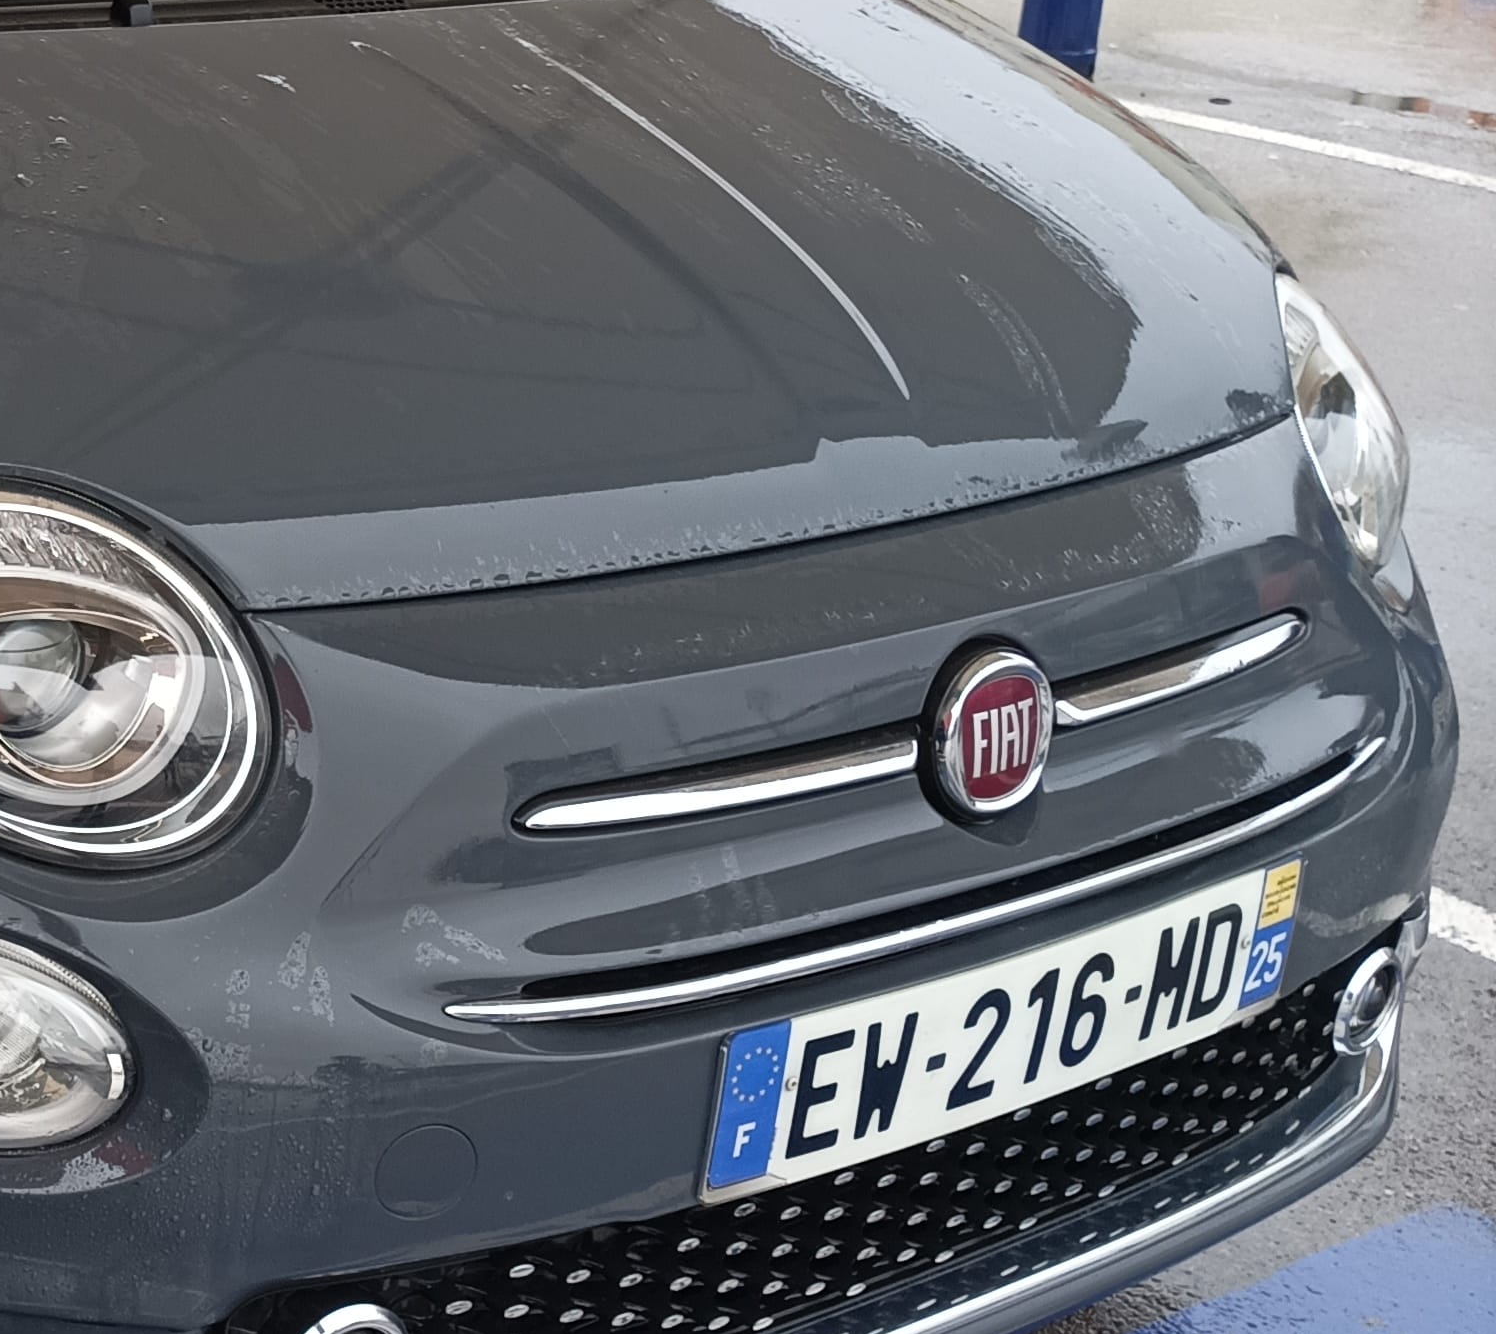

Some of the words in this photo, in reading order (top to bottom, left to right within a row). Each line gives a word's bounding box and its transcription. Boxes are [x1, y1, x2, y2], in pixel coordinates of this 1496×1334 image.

[971, 696, 1035, 780] FIAT
[731, 1121, 757, 1159] F
[783, 902, 1244, 1160] EW-216-MD
[1243, 931, 1288, 993] 25
